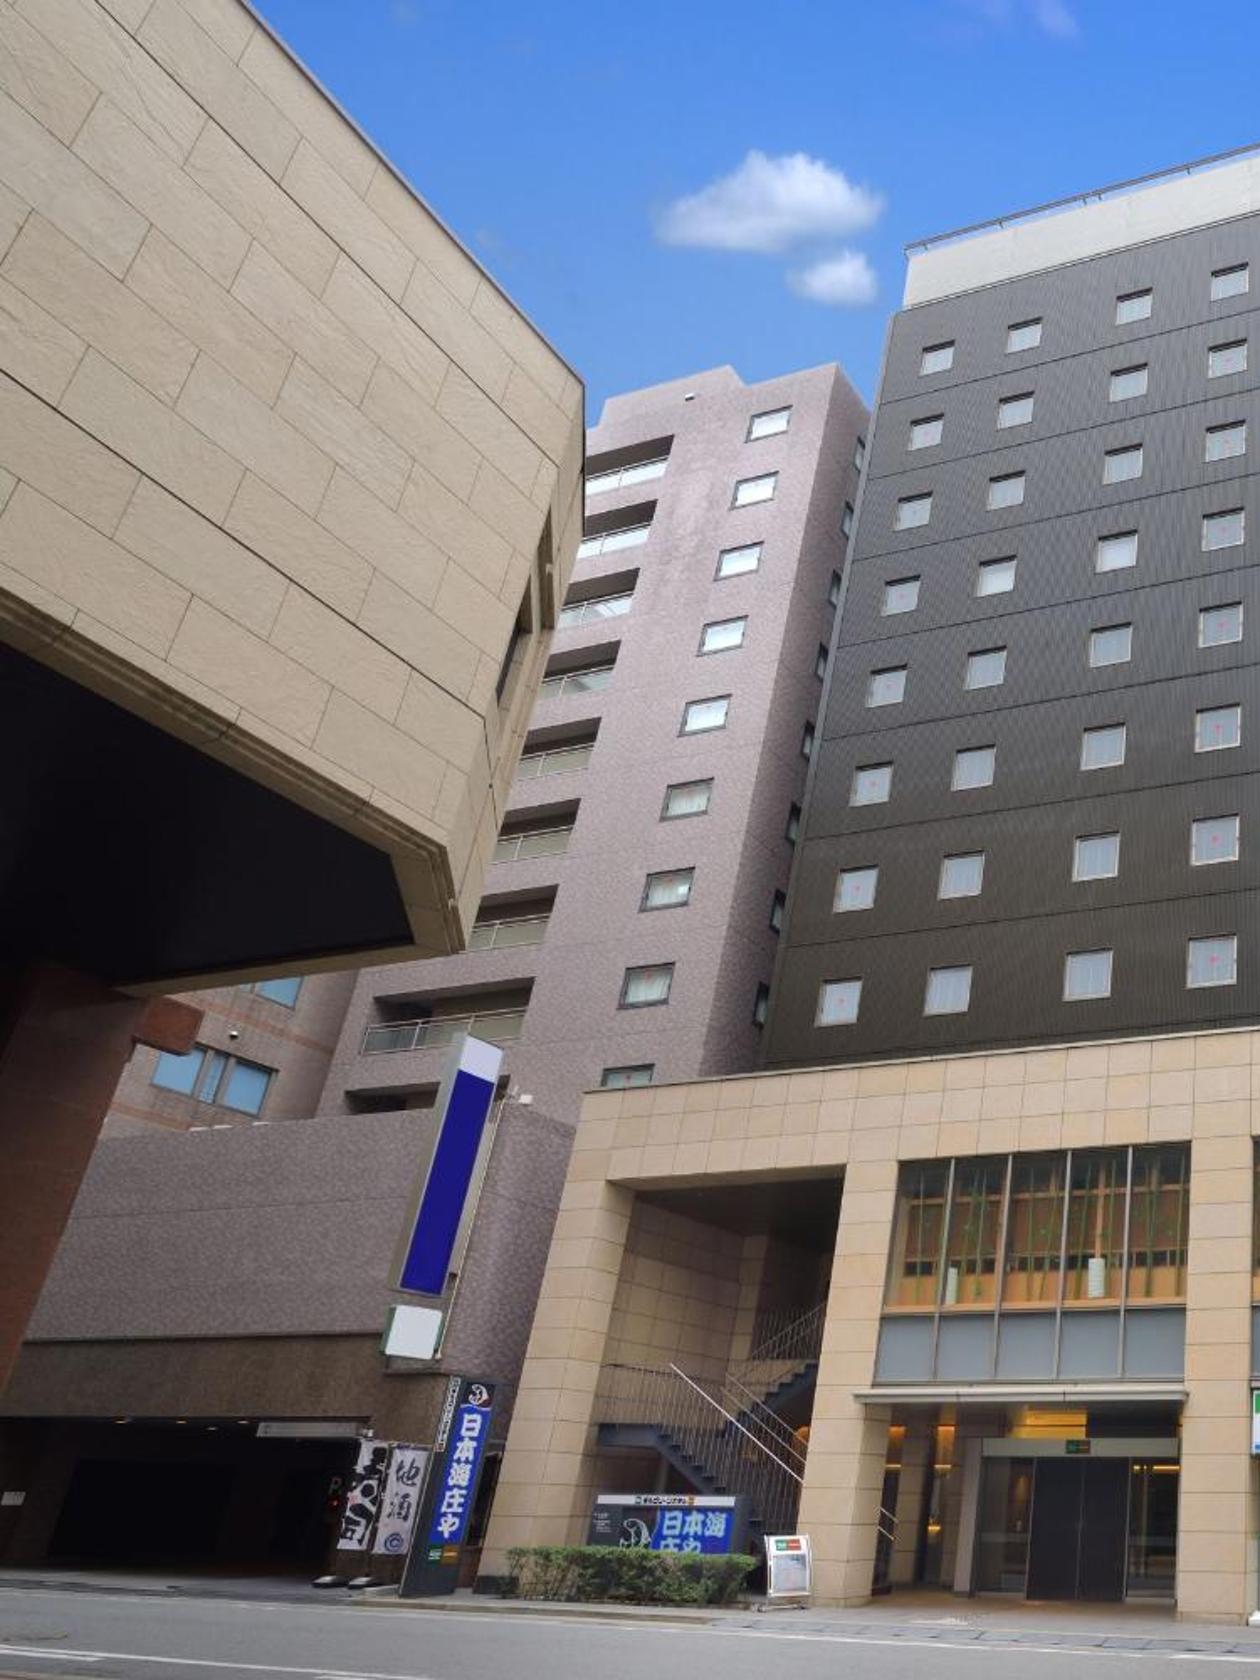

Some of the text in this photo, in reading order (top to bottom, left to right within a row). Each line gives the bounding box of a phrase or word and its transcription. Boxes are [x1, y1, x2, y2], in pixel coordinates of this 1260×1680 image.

[437, 1413, 482, 1539] 日本海庄や
[663, 1510, 727, 1537] 日本海
